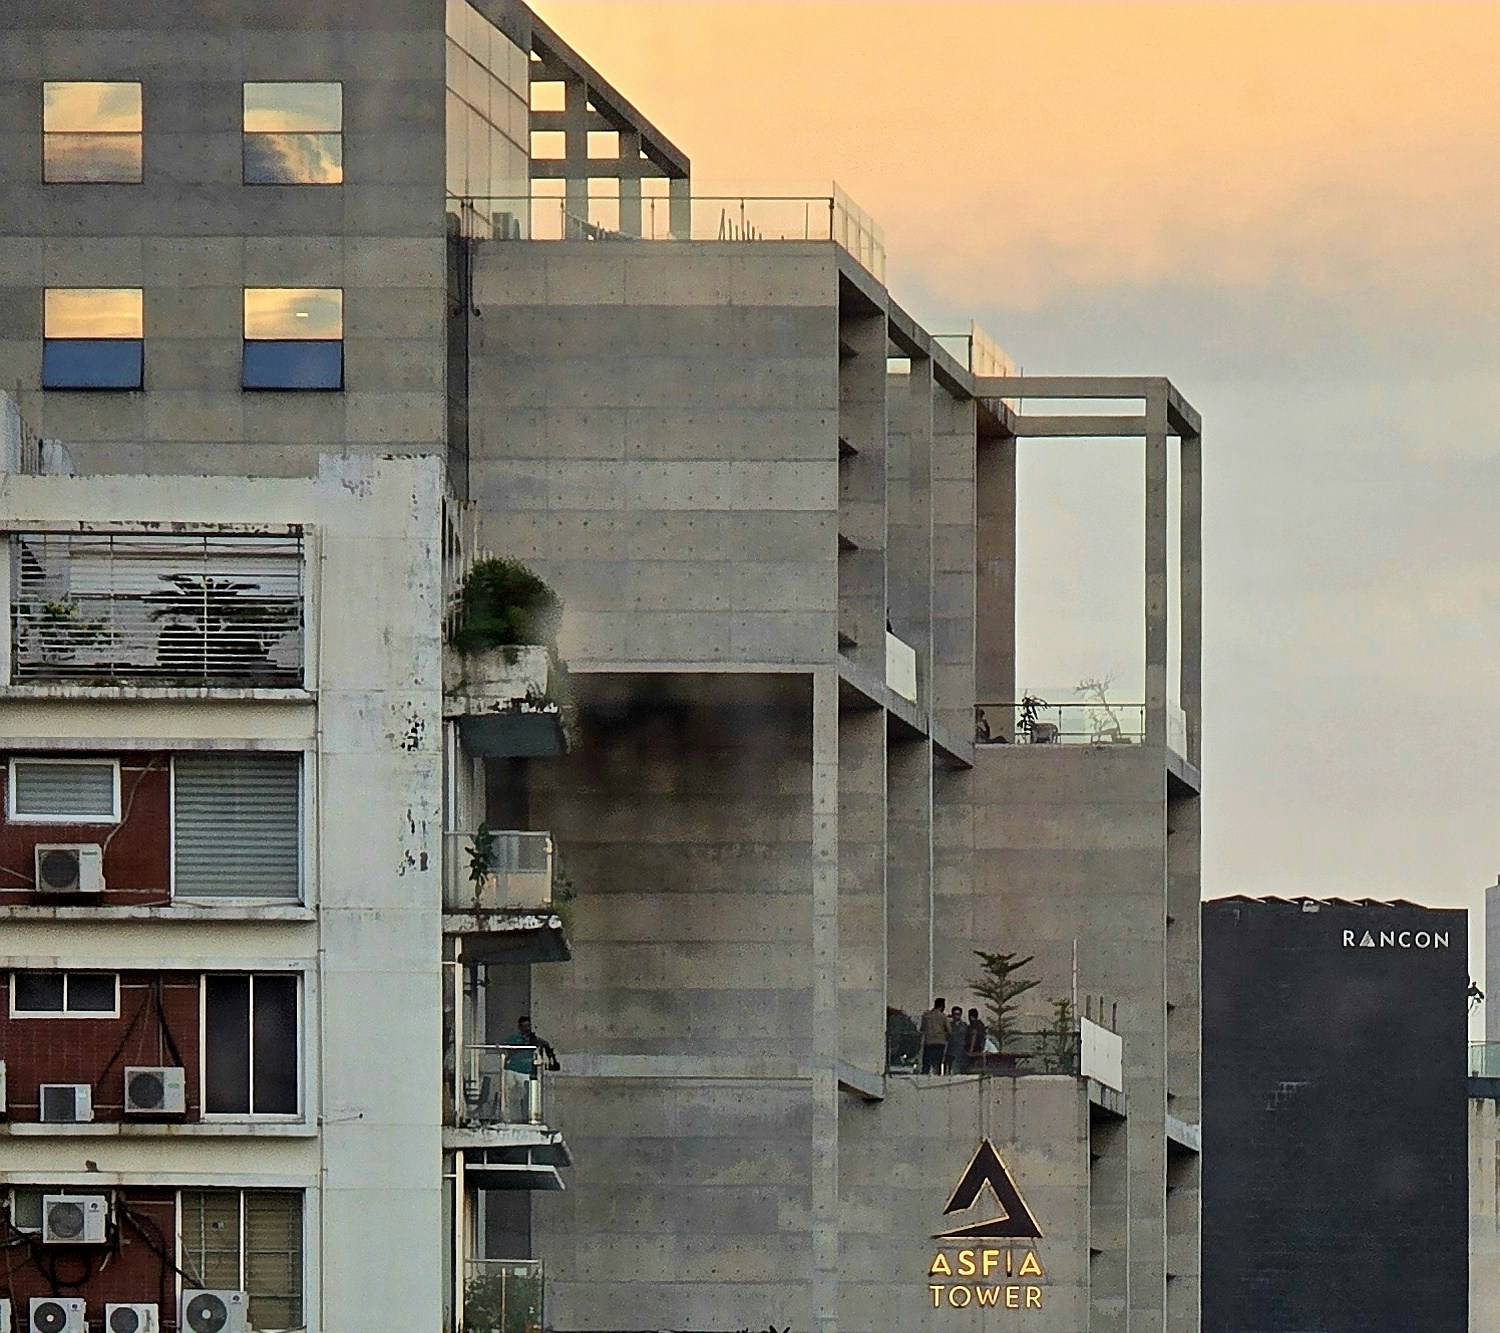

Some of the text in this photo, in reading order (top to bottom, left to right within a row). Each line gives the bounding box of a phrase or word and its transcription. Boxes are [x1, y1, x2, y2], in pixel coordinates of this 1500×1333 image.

[1342, 929, 1449, 949] RANCON
[929, 1249, 1043, 1277] ASFIA
[929, 1285, 1043, 1308] TOWER
